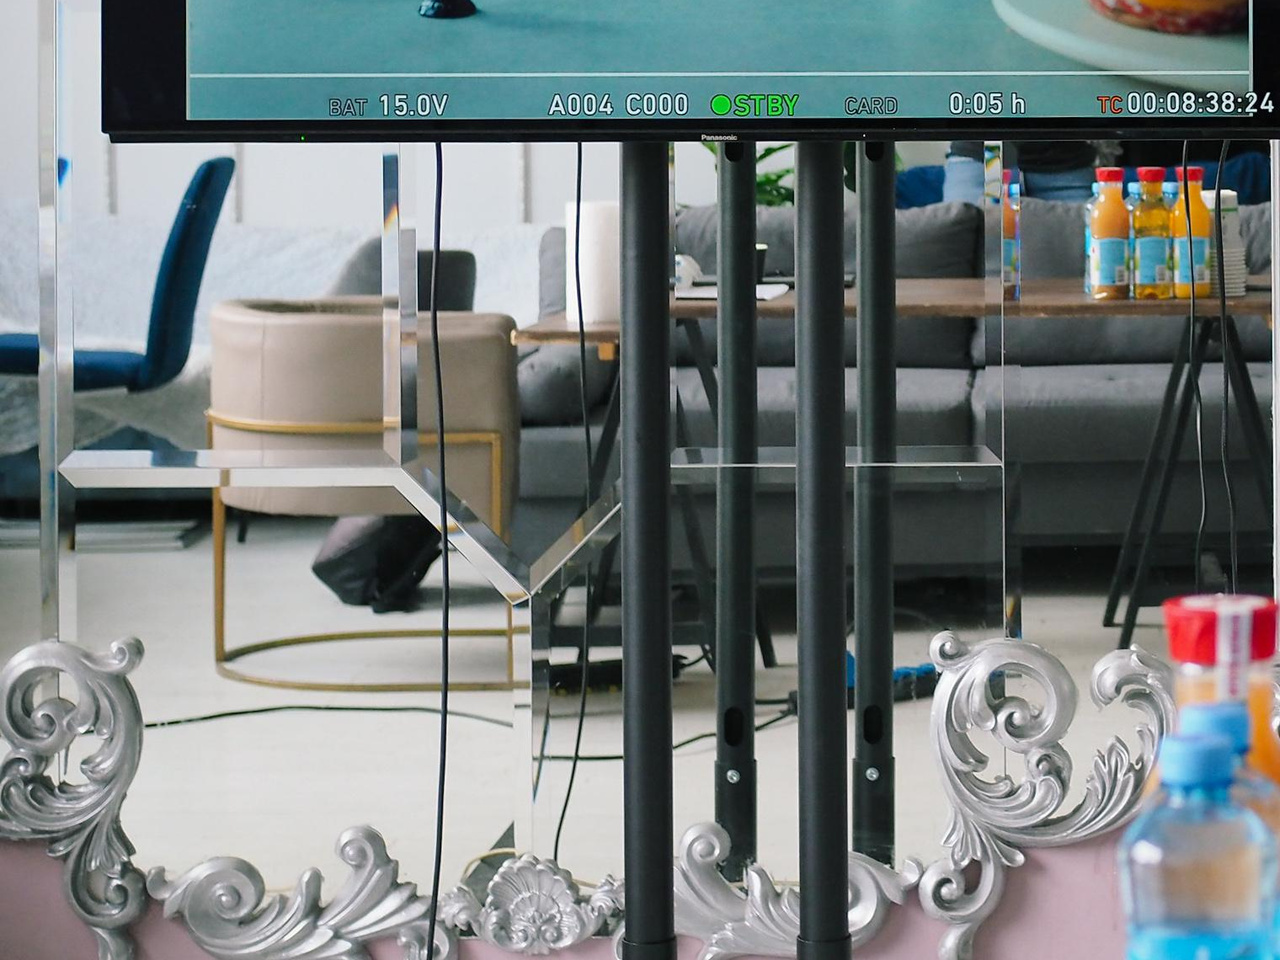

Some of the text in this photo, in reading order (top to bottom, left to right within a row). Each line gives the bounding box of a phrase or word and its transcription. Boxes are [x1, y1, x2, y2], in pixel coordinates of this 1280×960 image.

[328, 94, 449, 117] BAT 15.0V
[547, 93, 689, 116] A004 C000
[732, 93, 800, 117] STBY
[844, 91, 1026, 115] CARD 0:05 h
[1097, 92, 1275, 115] TC 00:08:38:24
[701, 133, 738, 141] Panasonic
